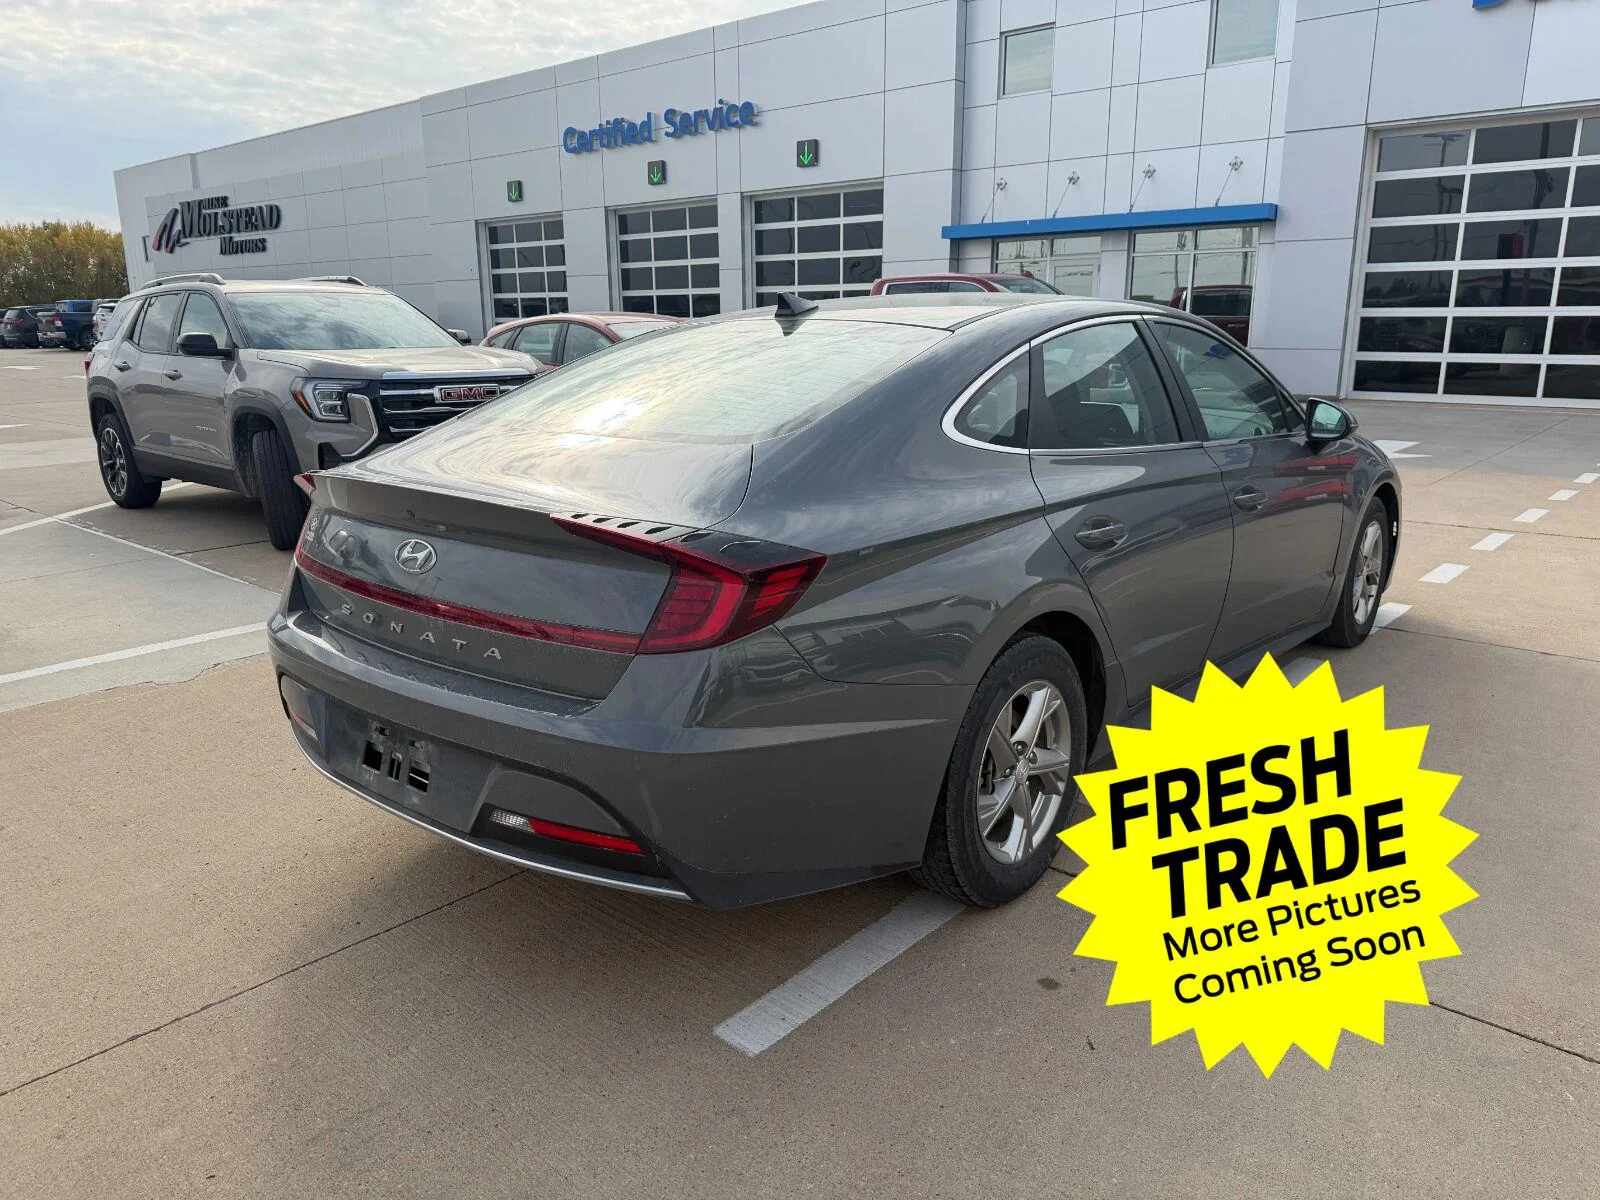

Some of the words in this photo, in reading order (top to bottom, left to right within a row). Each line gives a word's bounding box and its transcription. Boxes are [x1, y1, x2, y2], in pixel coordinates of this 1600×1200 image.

[563, 112, 656, 154] Certified
[664, 98, 758, 138] Service
[179, 200, 282, 239] MOLSTEAD
[219, 236, 267, 256] MOTORS
[441, 386, 500, 401] GMC
[341, 603, 502, 660] SONATA
